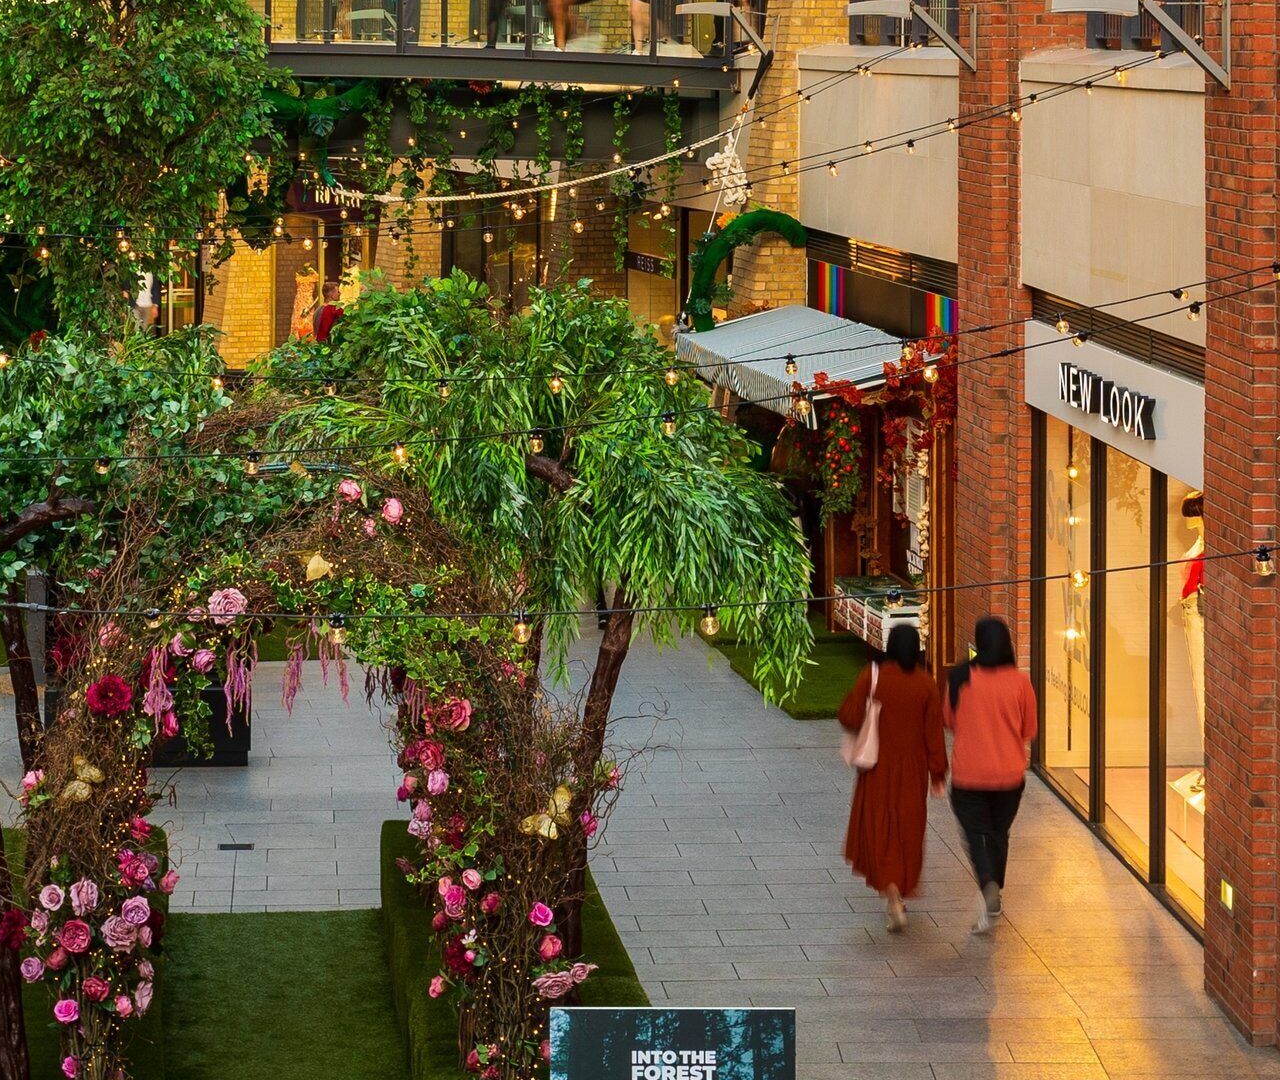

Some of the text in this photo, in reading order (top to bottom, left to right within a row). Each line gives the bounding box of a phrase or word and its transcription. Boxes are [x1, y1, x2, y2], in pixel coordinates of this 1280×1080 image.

[1059, 363, 1149, 440] NEW LOOK
[631, 1050, 717, 1065] INTO THE
[631, 1065, 717, 1080] FOREST
